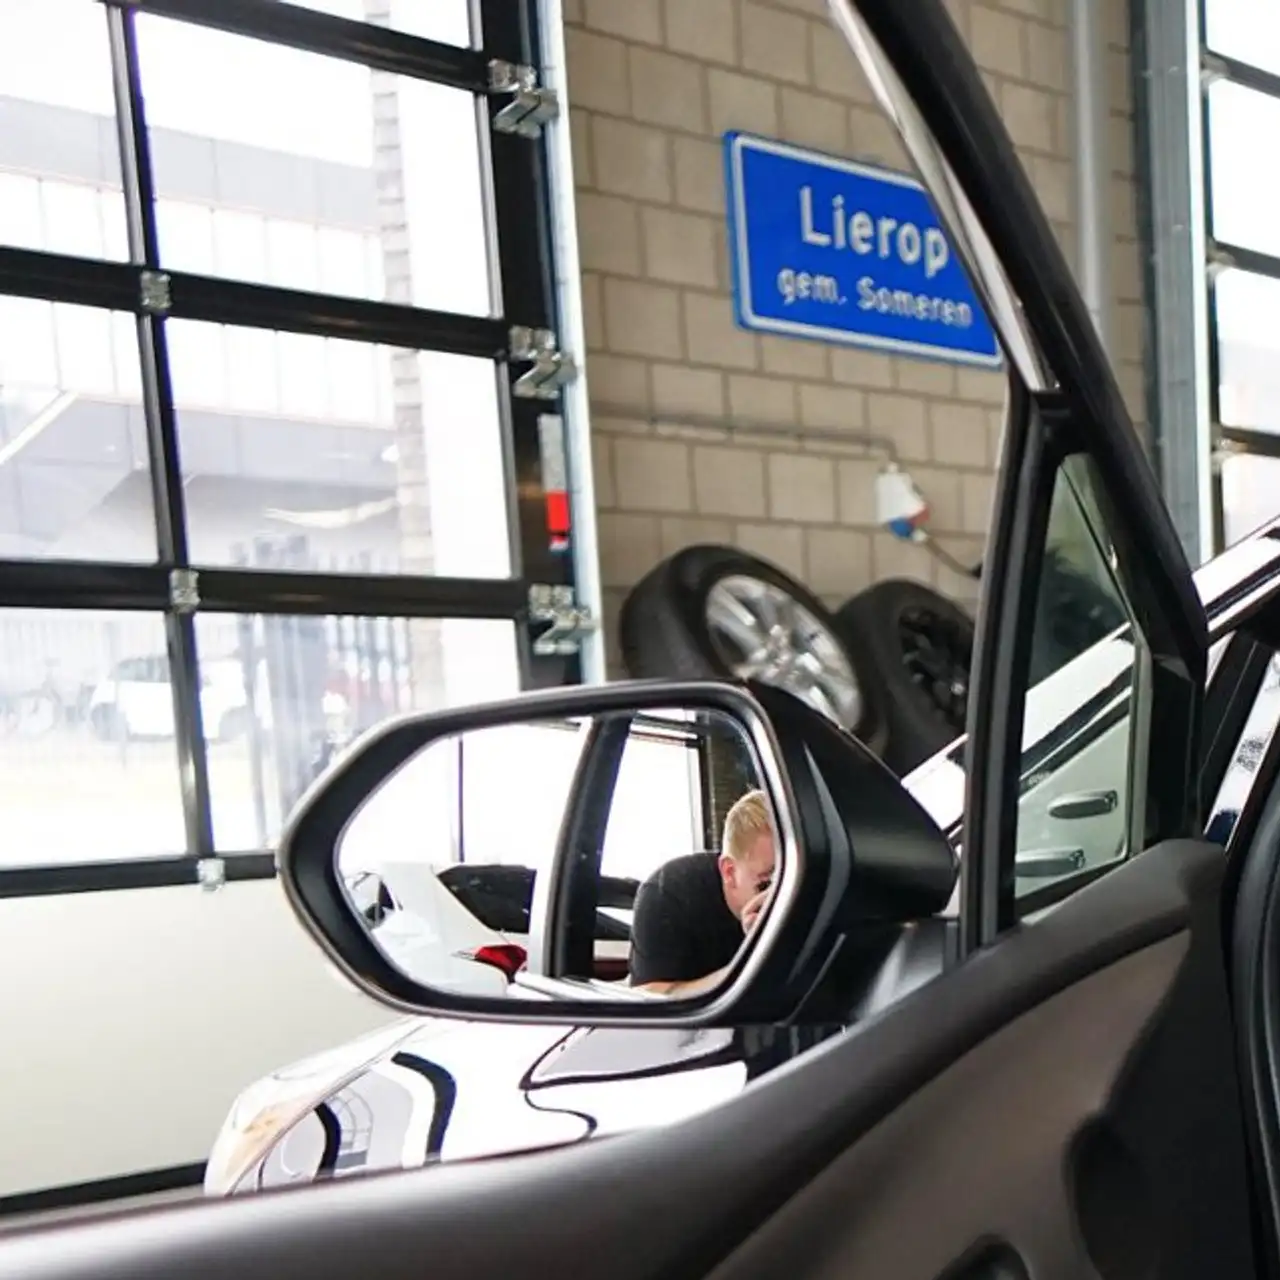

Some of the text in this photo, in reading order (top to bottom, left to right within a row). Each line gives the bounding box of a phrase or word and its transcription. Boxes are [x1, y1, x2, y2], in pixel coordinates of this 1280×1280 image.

[800, 186, 948, 278] Lierop
[778, 268, 973, 327] gem. Someren
